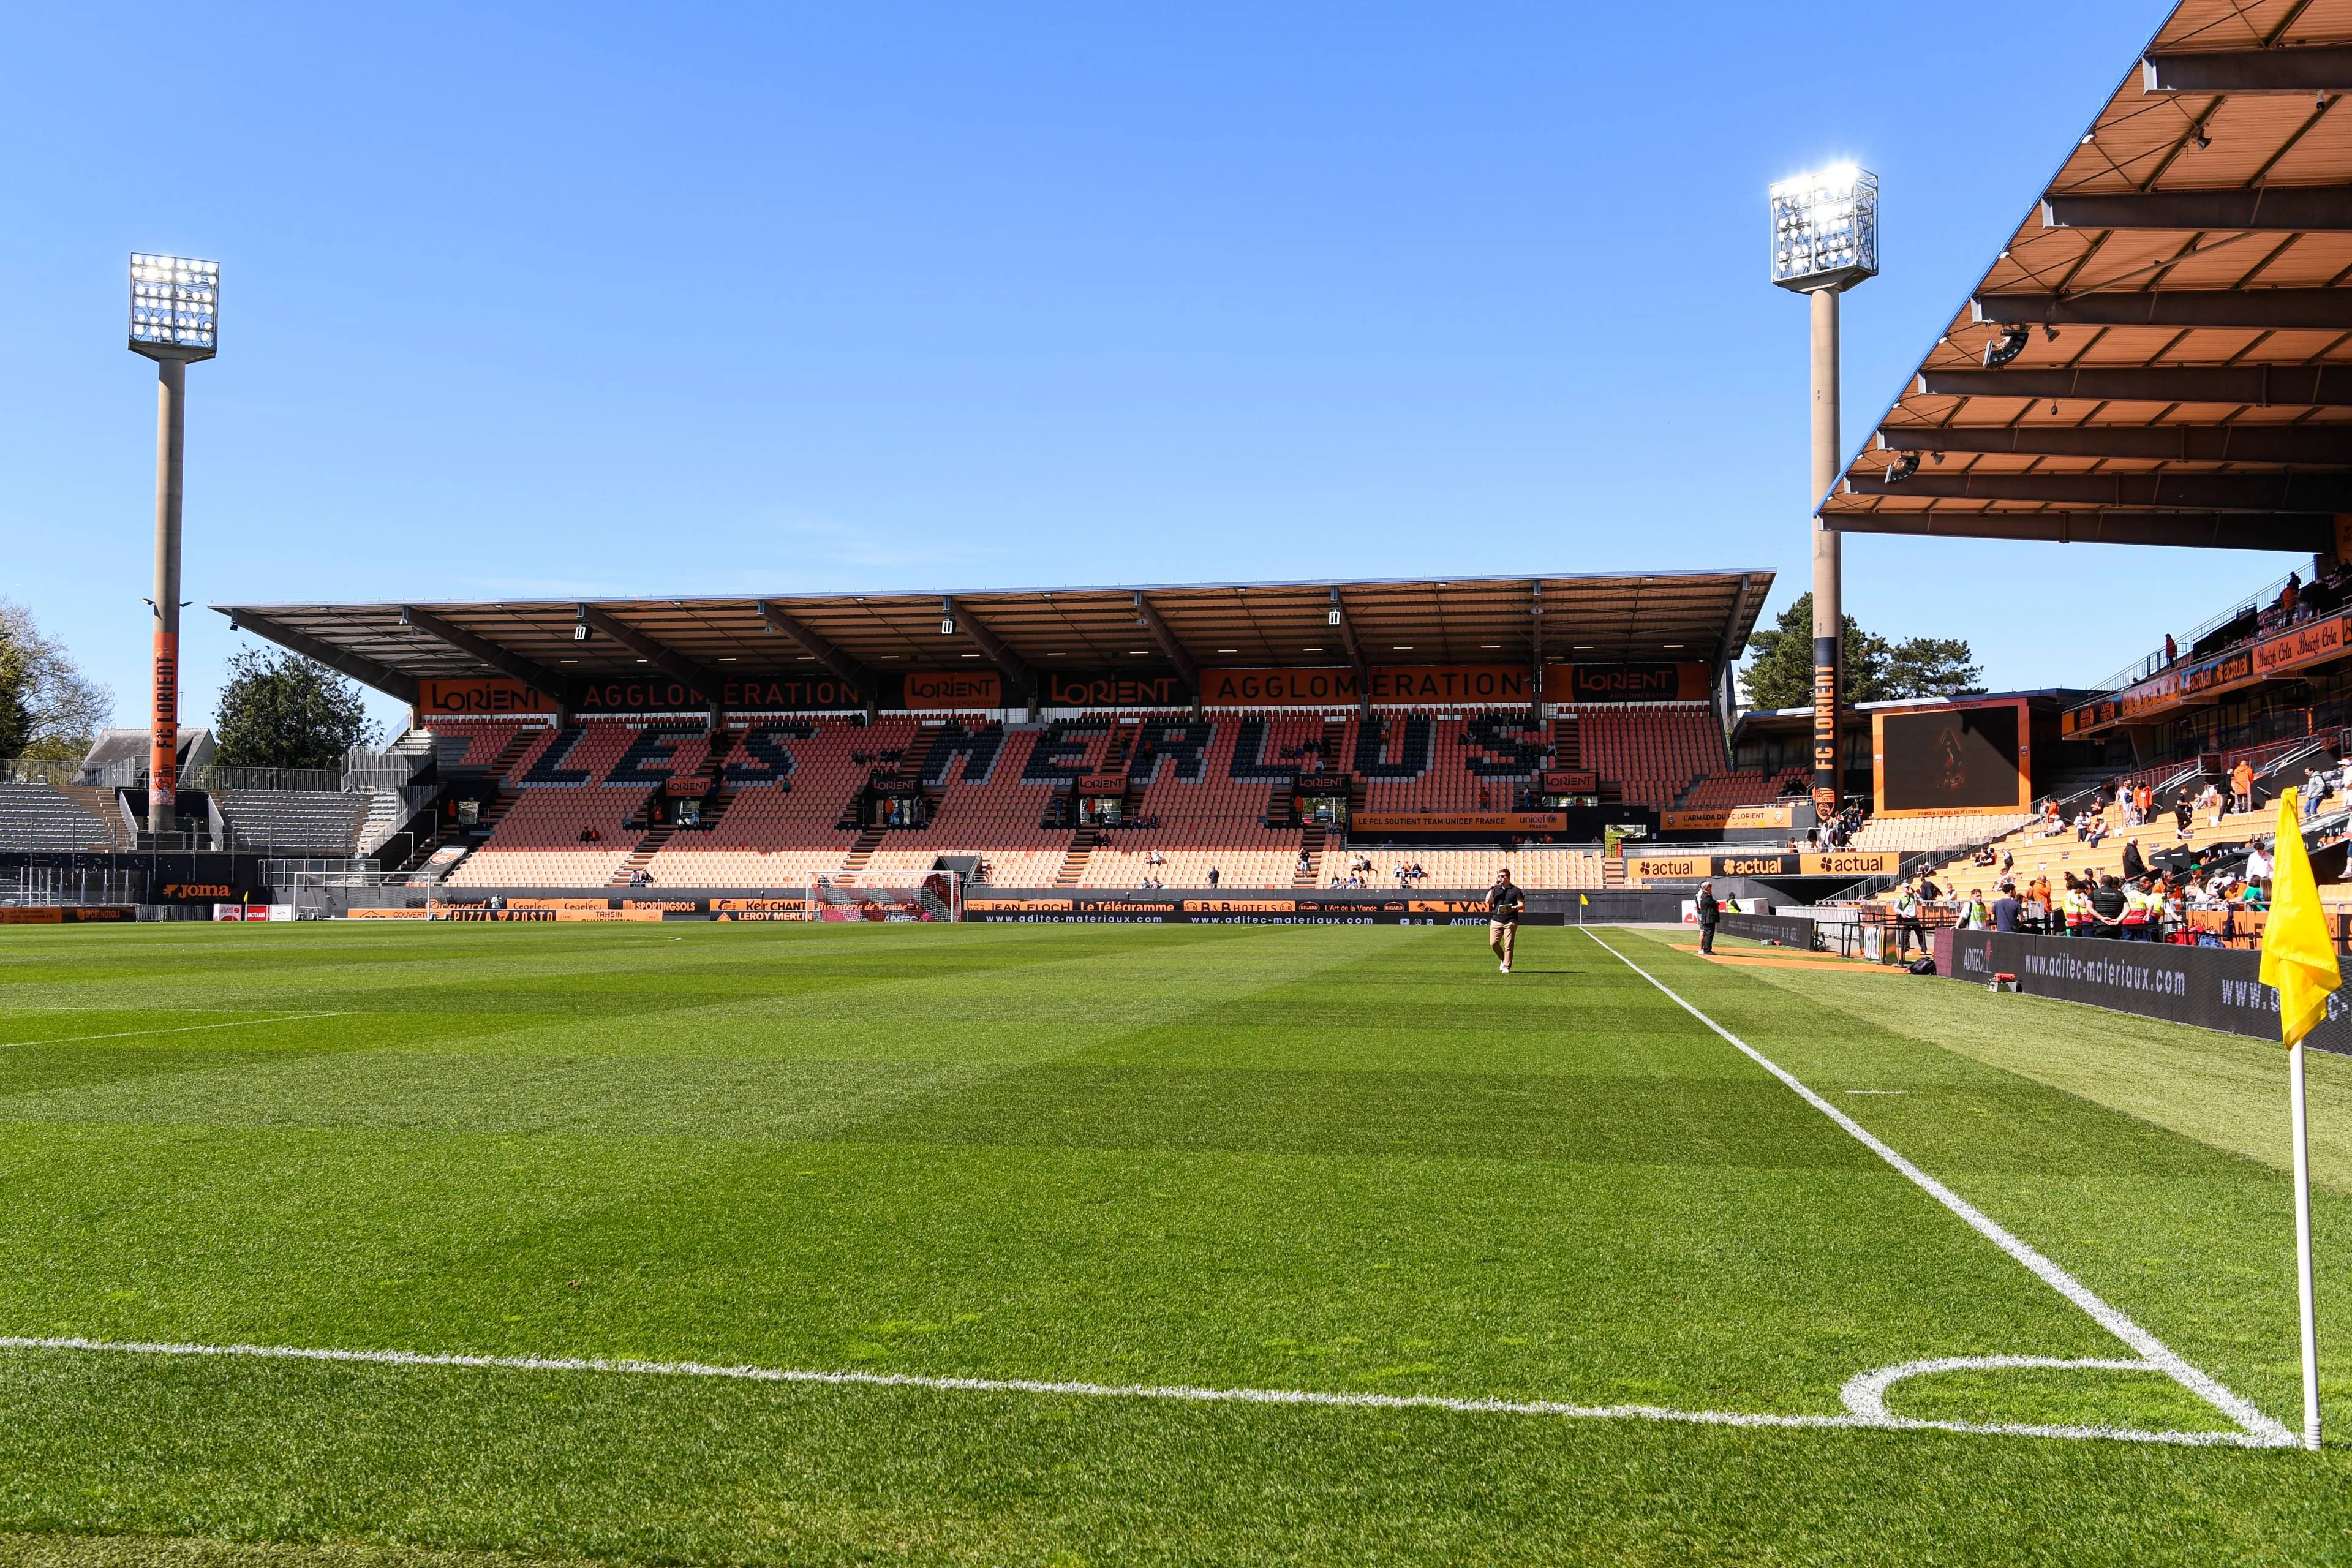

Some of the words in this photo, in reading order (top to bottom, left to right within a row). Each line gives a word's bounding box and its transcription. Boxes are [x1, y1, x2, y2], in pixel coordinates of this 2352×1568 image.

[2257, 647, 2277, 668] Breizh
[2278, 642, 2292, 662] Cola
[2297, 631, 2319, 655] Breizh
[2322, 627, 2337, 647] Cola
[2190, 665, 2211, 692] actual
[2223, 653, 2248, 680] actual
[157, 657, 174, 722] LORIENT
[1815, 665, 1833, 741] LORIENT
[157, 728, 174, 748] FC
[1815, 747, 1833, 770] FC
[1519, 814, 1547, 824] unicef
[1652, 861, 1693, 875] actual
[1736, 858, 1781, 874] actual
[1834, 856, 1883, 872] actual
[636, 902, 695, 911] SPORTINGSOLS
[746, 900, 767, 910] Ker
[864, 902, 875, 911] de
[988, 902, 1020, 911] JEAN
[1080, 902, 1094, 911] Le
[1096, 900, 1175, 911] Télégramme
[513, 911, 554, 921] POSTO
[738, 911, 771, 921] LEROY
[774, 911, 813, 921] MERLIN
[986, 914, 1162, 923] www.aditec-materiaux.com
[1191, 916, 1373, 924] www.aditec-materiaux.com
[1963, 948, 1984, 972] ADITEC
[2025, 952, 2185, 997] www.aditec-materiaux.com
